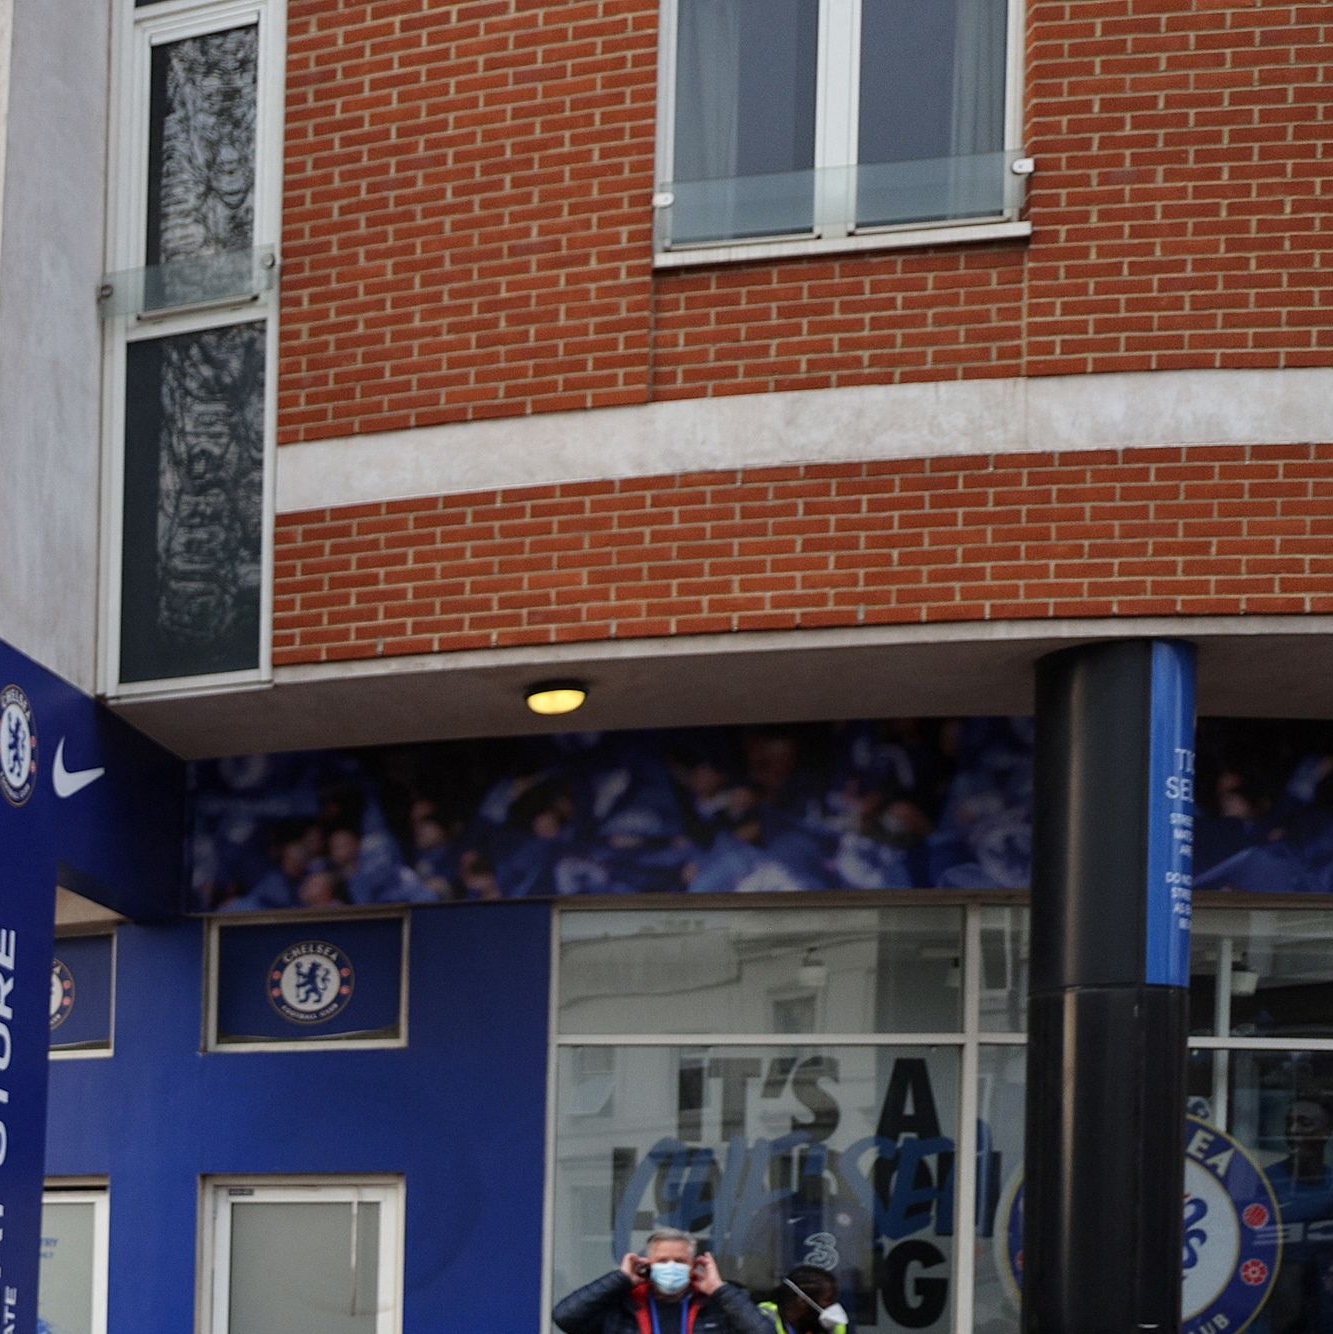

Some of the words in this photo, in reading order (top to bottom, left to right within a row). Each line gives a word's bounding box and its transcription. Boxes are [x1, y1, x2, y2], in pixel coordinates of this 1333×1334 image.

[283, 943, 338, 962] CHELSEA
[677, 1056, 841, 1143] IT'S
[876, 1057, 941, 1143] A
